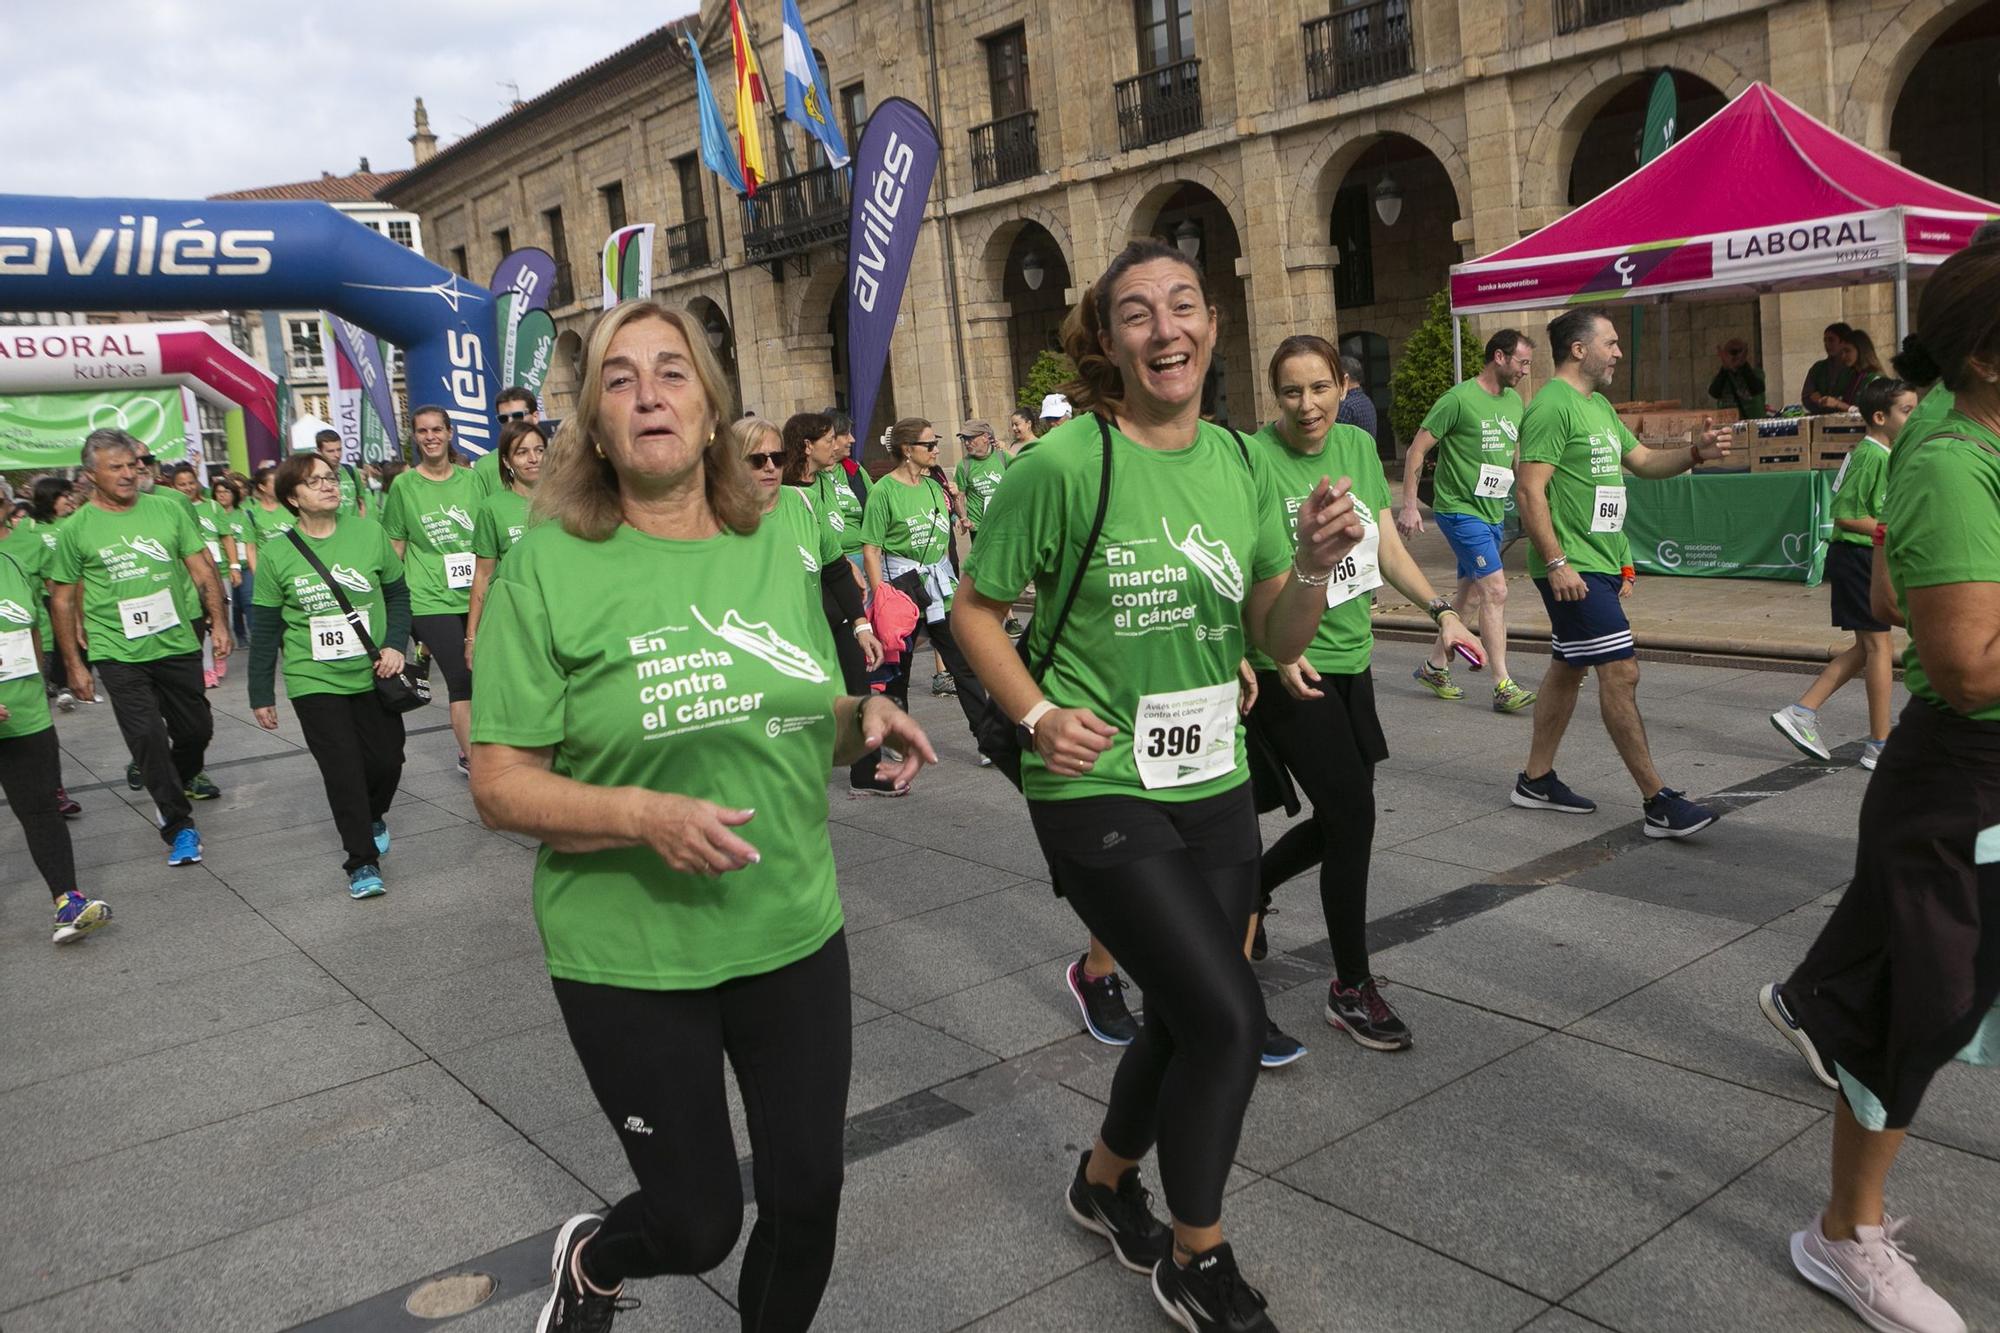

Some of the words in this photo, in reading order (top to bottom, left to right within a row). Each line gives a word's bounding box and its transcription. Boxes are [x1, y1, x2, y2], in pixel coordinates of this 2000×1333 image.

[854, 131, 914, 313] avilés
[0, 215, 275, 276] avilés
[1727, 219, 1876, 261] LABORAL
[0, 335, 144, 359] ABORAL
[73, 362, 147, 380] kutxa
[1483, 476, 1499, 489] 412
[1600, 502, 1619, 518] 694
[1106, 546, 1136, 566] En
[451, 564, 472, 578] 236
[1109, 564, 1188, 587] marcha
[296, 582, 331, 596] march
[1111, 588, 1178, 607] contra
[132, 610, 149, 625] 97
[1114, 610, 1131, 628] el
[1138, 604, 1197, 627] cáncer
[318, 631, 345, 647] 183
[629, 636, 667, 656] En
[636, 648, 734, 680] marcha
[639, 672, 727, 704] contra
[642, 704, 667, 730] el
[676, 692, 764, 723] cáncer
[1147, 724, 1202, 758] 396
